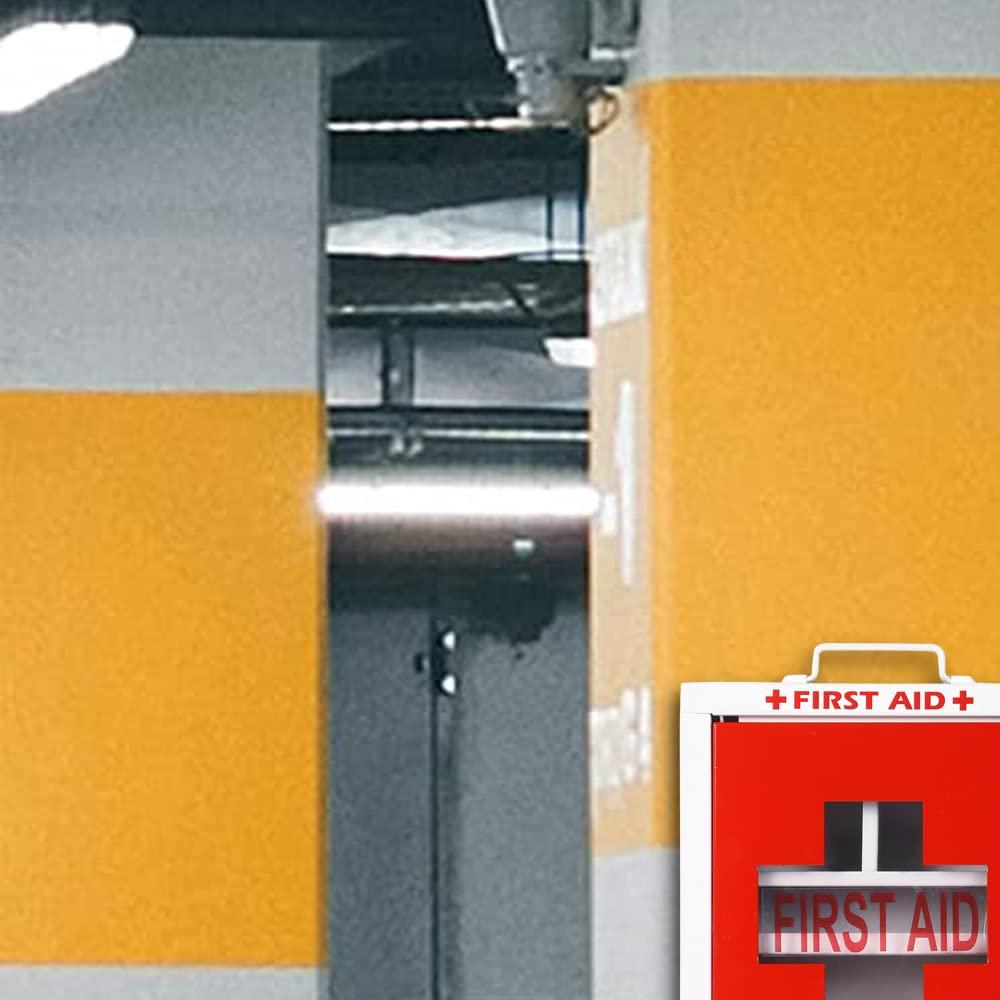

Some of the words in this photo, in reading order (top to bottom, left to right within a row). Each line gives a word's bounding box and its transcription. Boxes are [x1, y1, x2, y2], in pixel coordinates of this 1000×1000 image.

[793, 690, 879, 710] FIRST
[888, 690, 946, 710] AID
[773, 890, 896, 953] FIRST
[906, 890, 979, 952] AID
